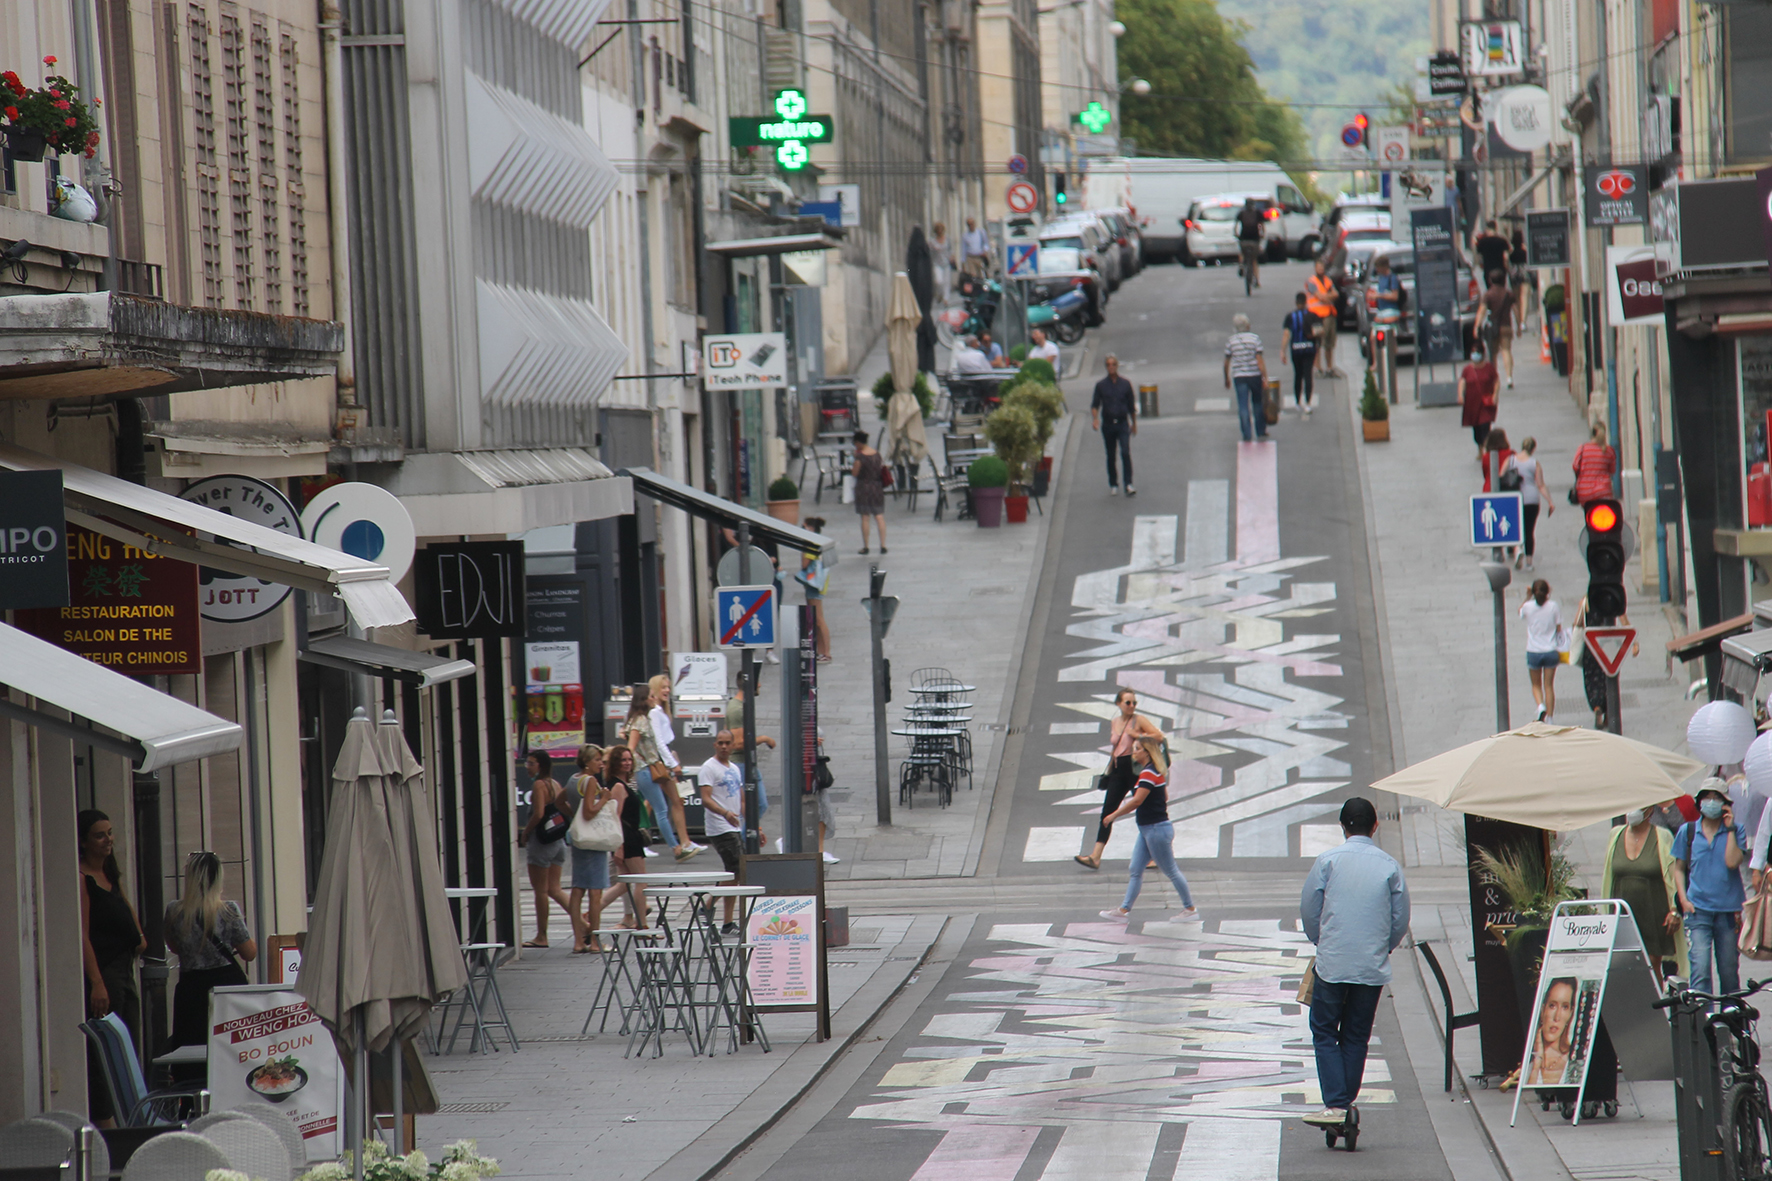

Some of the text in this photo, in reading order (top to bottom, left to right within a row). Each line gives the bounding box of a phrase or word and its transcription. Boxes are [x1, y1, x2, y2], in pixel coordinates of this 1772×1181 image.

[190, 486, 232, 505] ver
[242, 486, 274, 514] The
[0, 555, 45, 564] TRICOT
[204, 588, 259, 606] JOTT
[61, 605, 175, 619] RESTAURATION
[63, 628, 173, 642] SALON DE THE
[127, 651, 188, 664] CHINOIS
[1563, 918, 1607, 946] Borayale
[223, 1002, 303, 1031] NOUVEAU CHEZ
[238, 1011, 320, 1040] WENG HOA
[238, 1034, 313, 1064] BO BOUN
[301, 1113, 309, 1121] ET
[311, 1110, 320, 1118] DE
